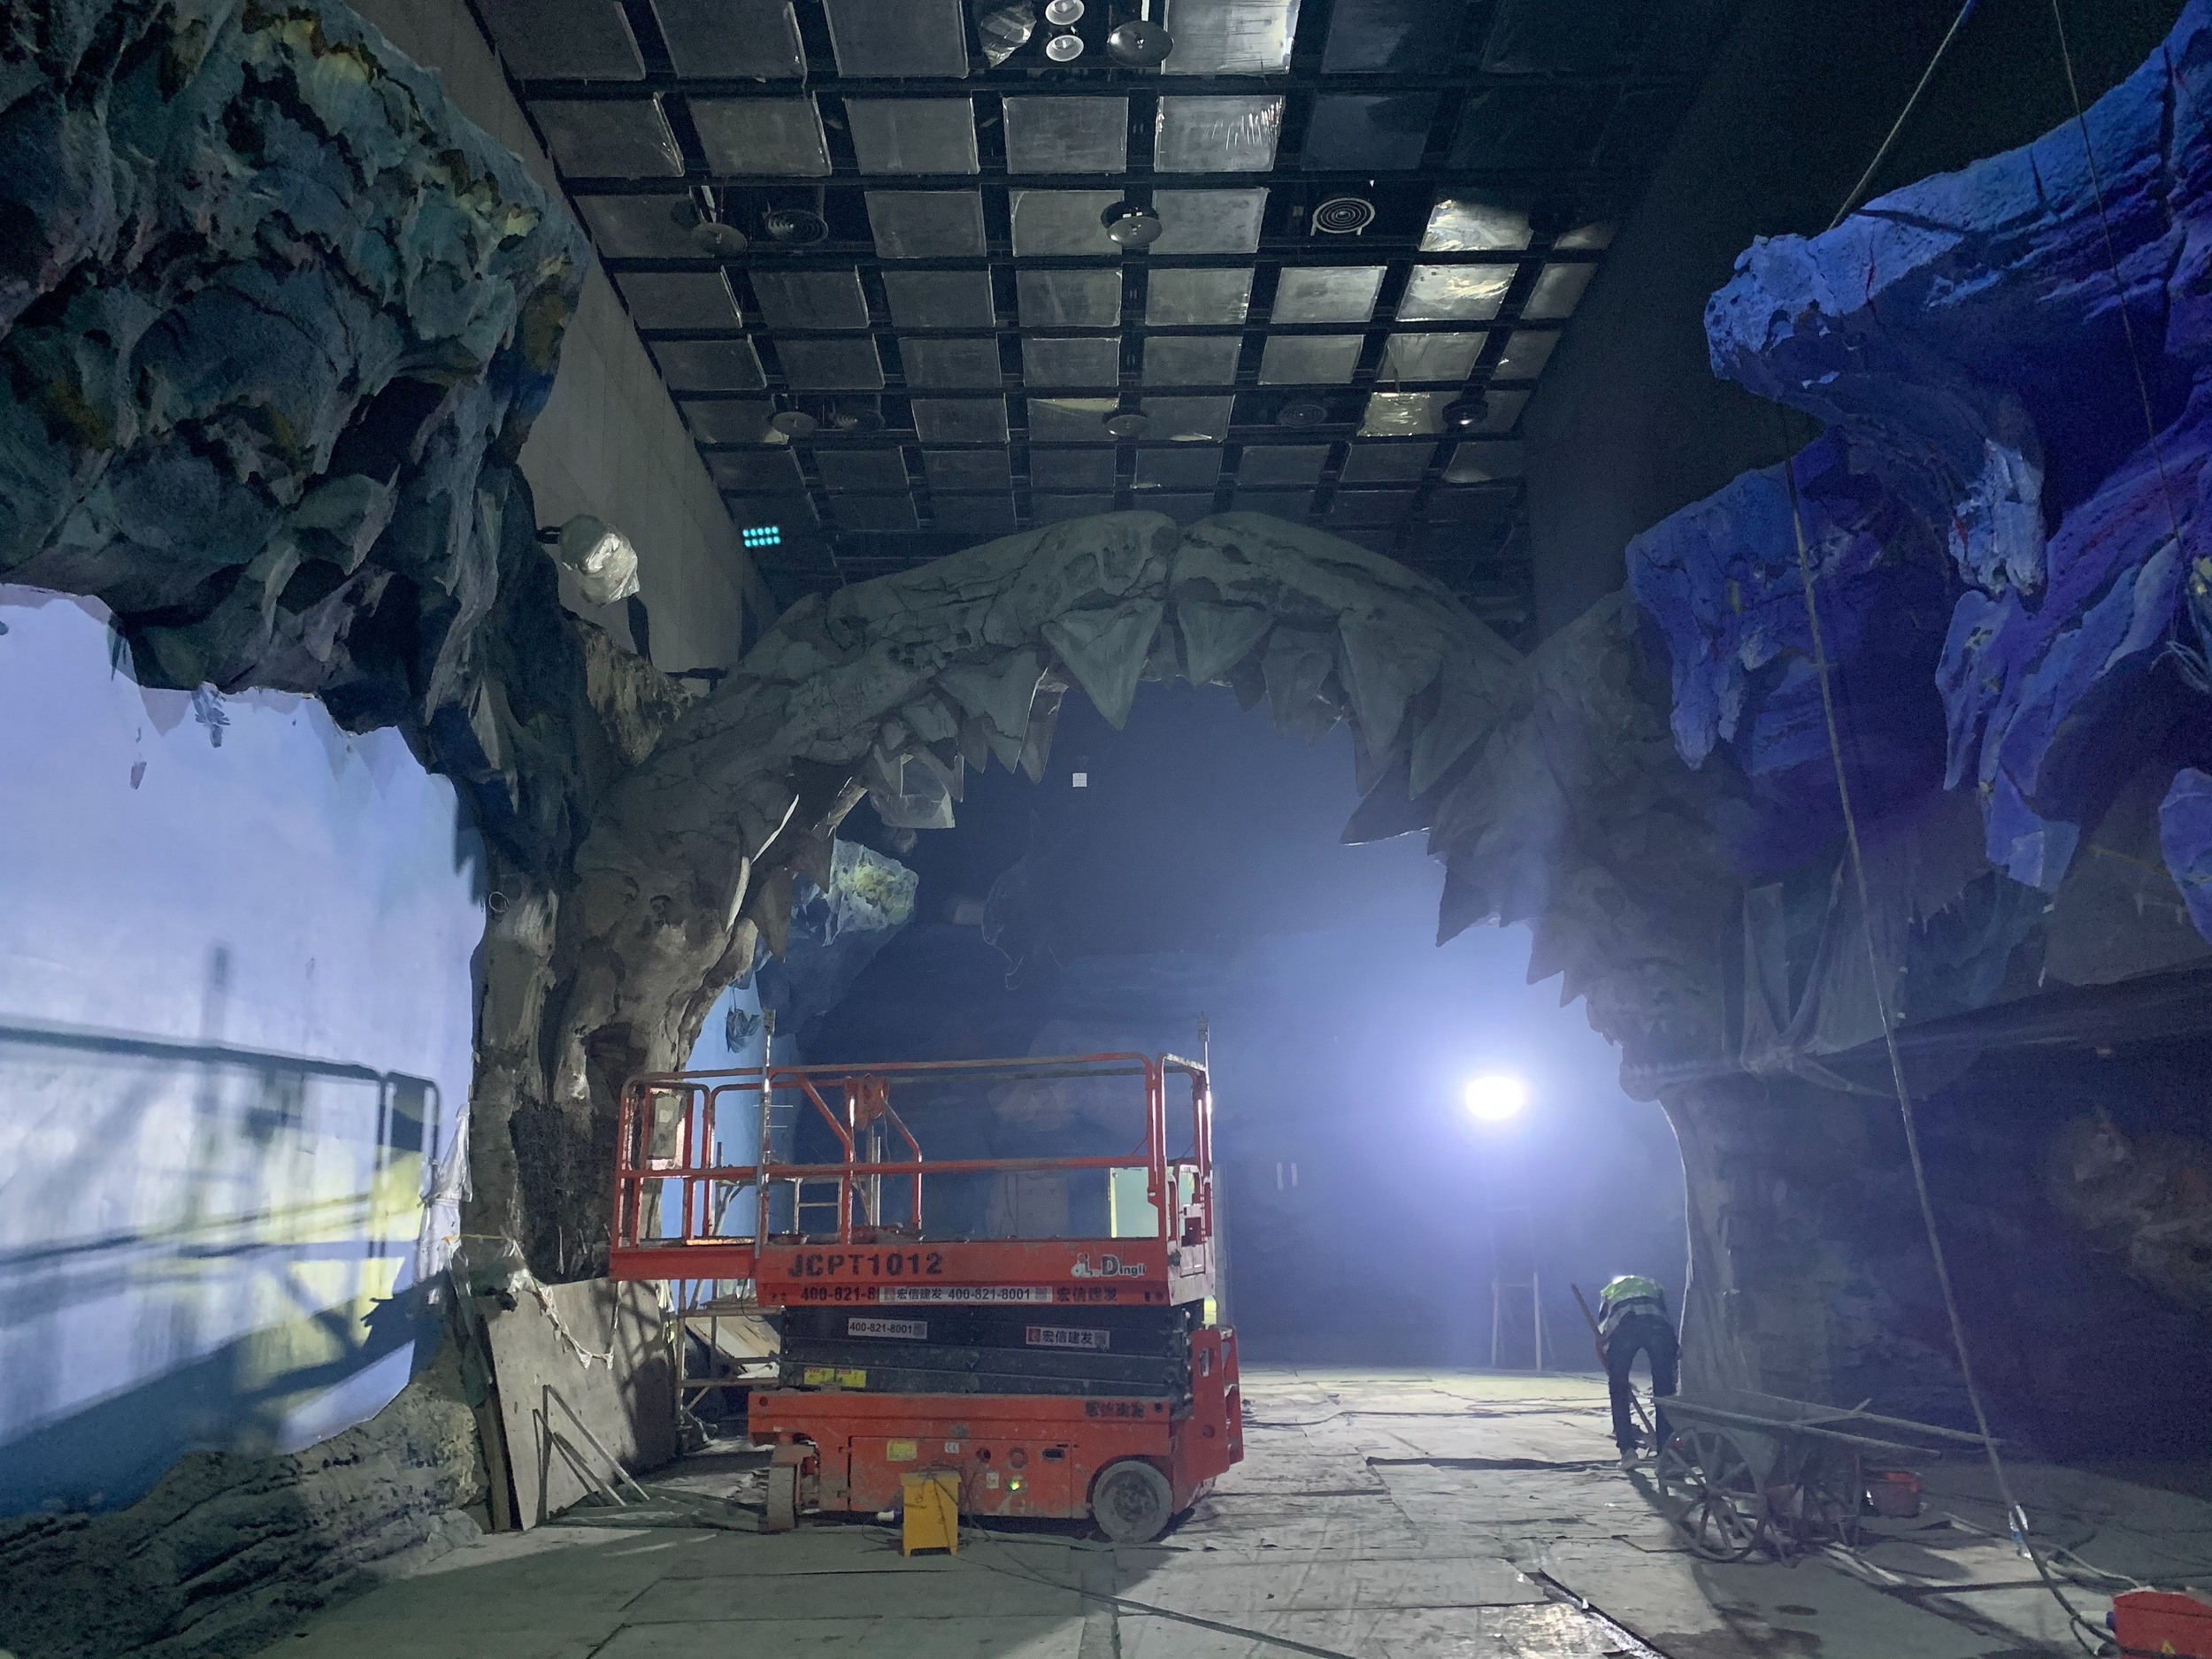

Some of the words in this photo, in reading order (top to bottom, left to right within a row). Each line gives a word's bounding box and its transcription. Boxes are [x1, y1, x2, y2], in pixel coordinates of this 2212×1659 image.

[787, 1250, 943, 1278] JCPT1012
[801, 1286, 880, 1302] 400-821-8
[896, 1287, 941, 1301] 宏信建发
[948, 1287, 1030, 1301] 400-821-8001
[849, 1322, 912, 1333] 400-821-8001
[1042, 1330, 1093, 1344] 宏信建发
